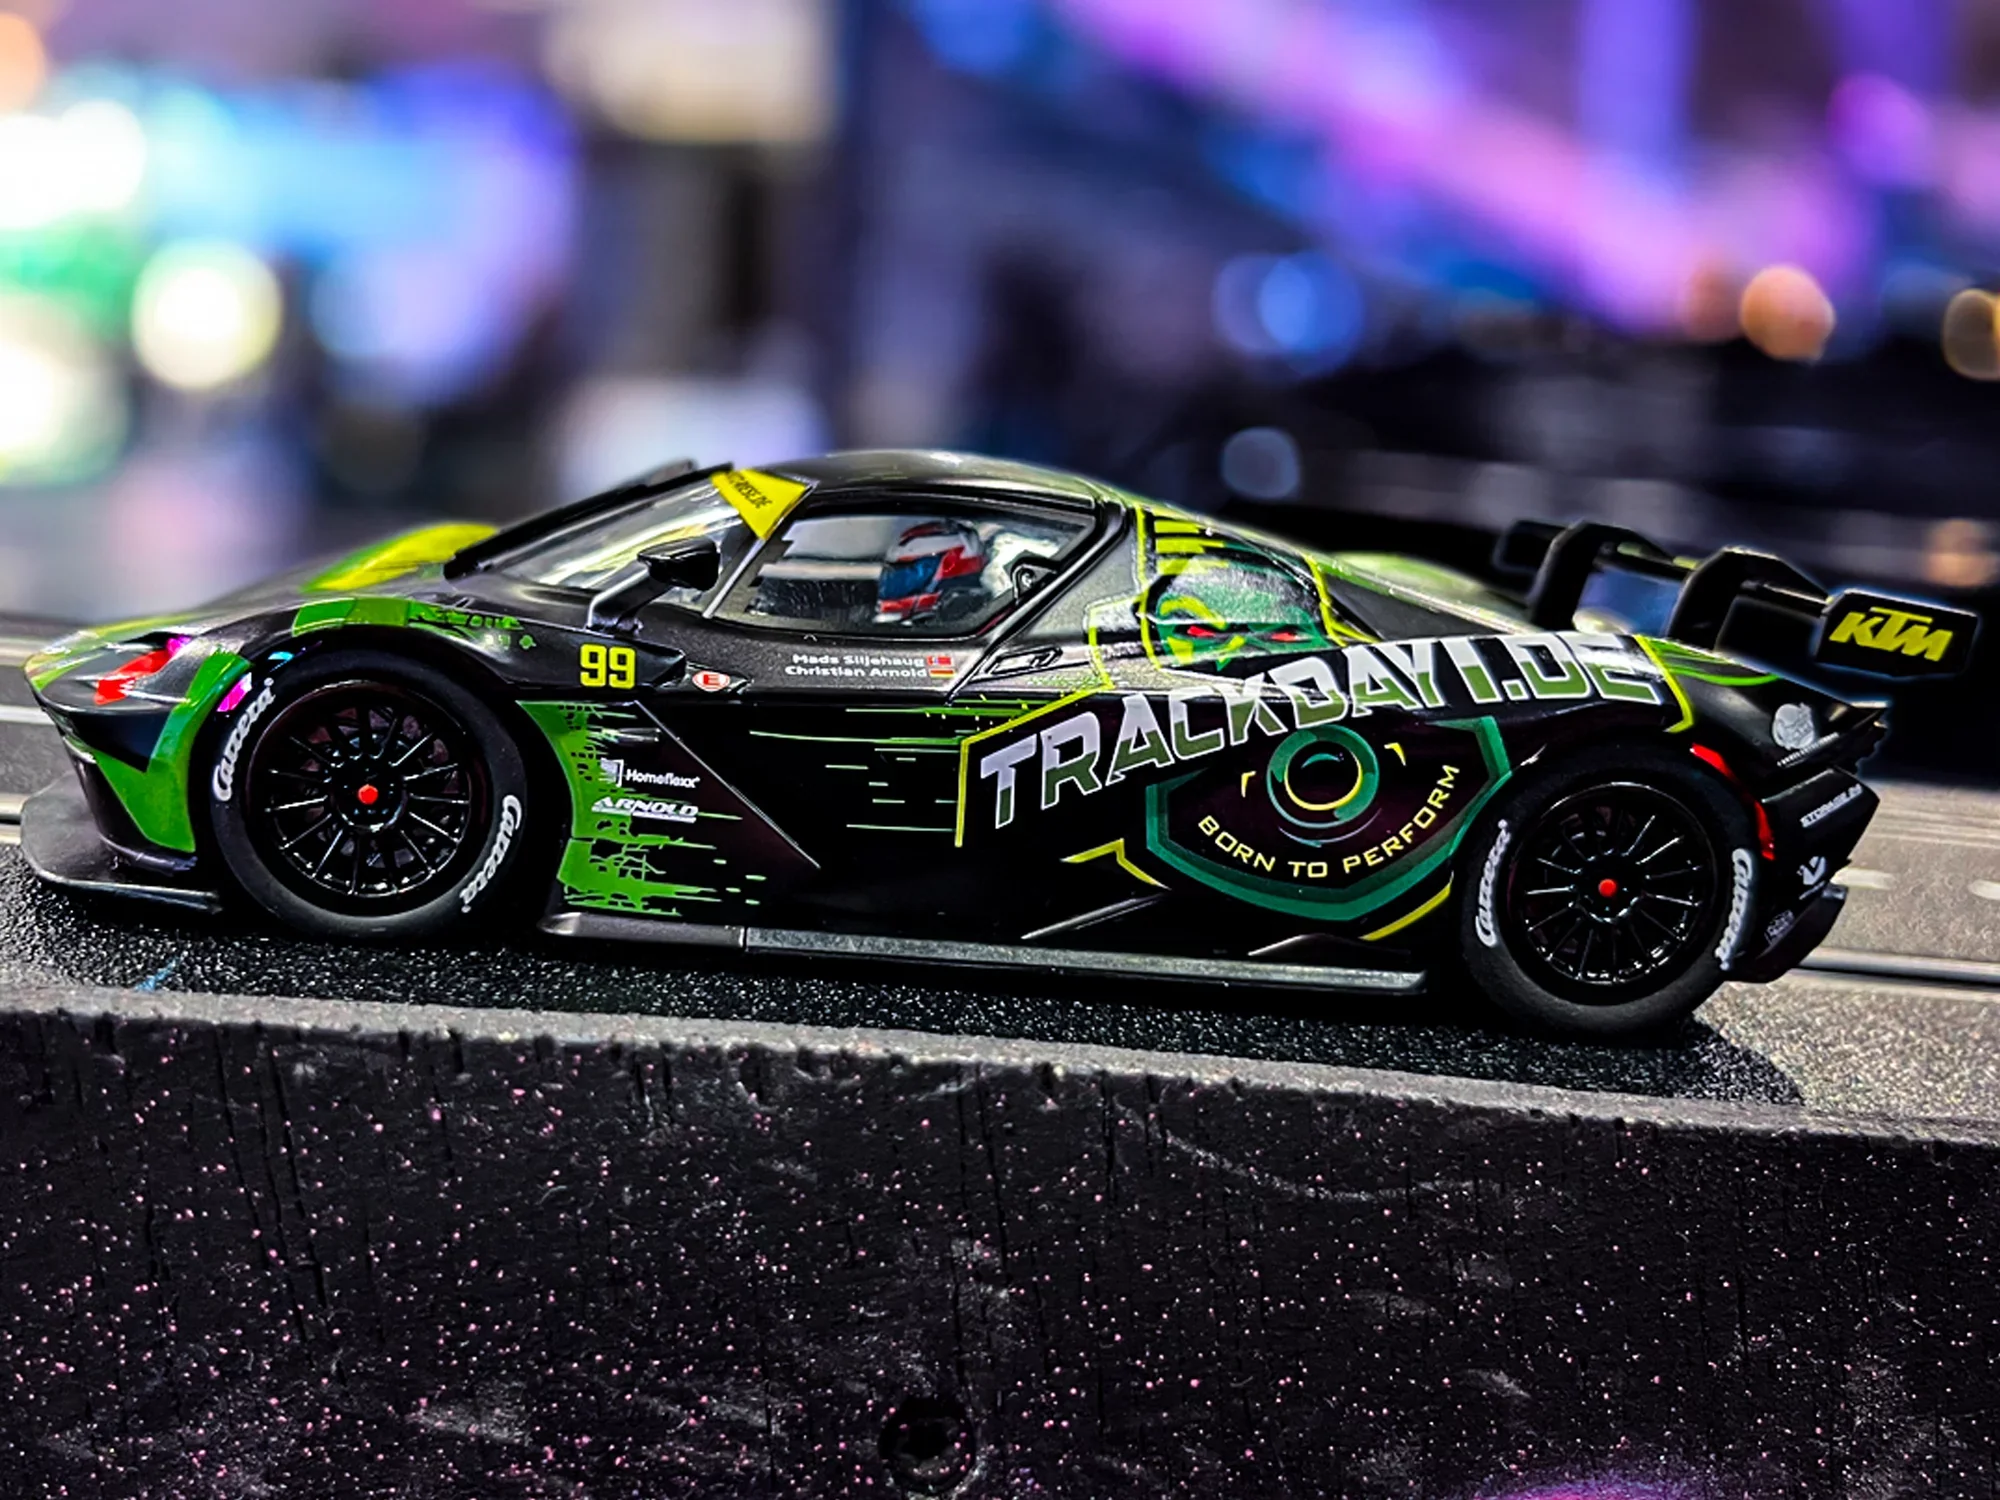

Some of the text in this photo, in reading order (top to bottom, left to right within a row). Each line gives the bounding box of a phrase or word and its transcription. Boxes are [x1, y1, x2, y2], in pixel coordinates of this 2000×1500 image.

[793, 653, 839, 664] Mads
[1829, 606, 1953, 662] KTM
[580, 643, 636, 689] 99
[785, 665, 928, 677] Christian Arnold
[212, 682, 276, 801] Carrera
[592, 797, 699, 818] ARNOLD
[1198, 764, 1460, 878] BORN TO PERFORM
[460, 795, 522, 908] Carrera
[1475, 824, 1511, 947] Carrera
